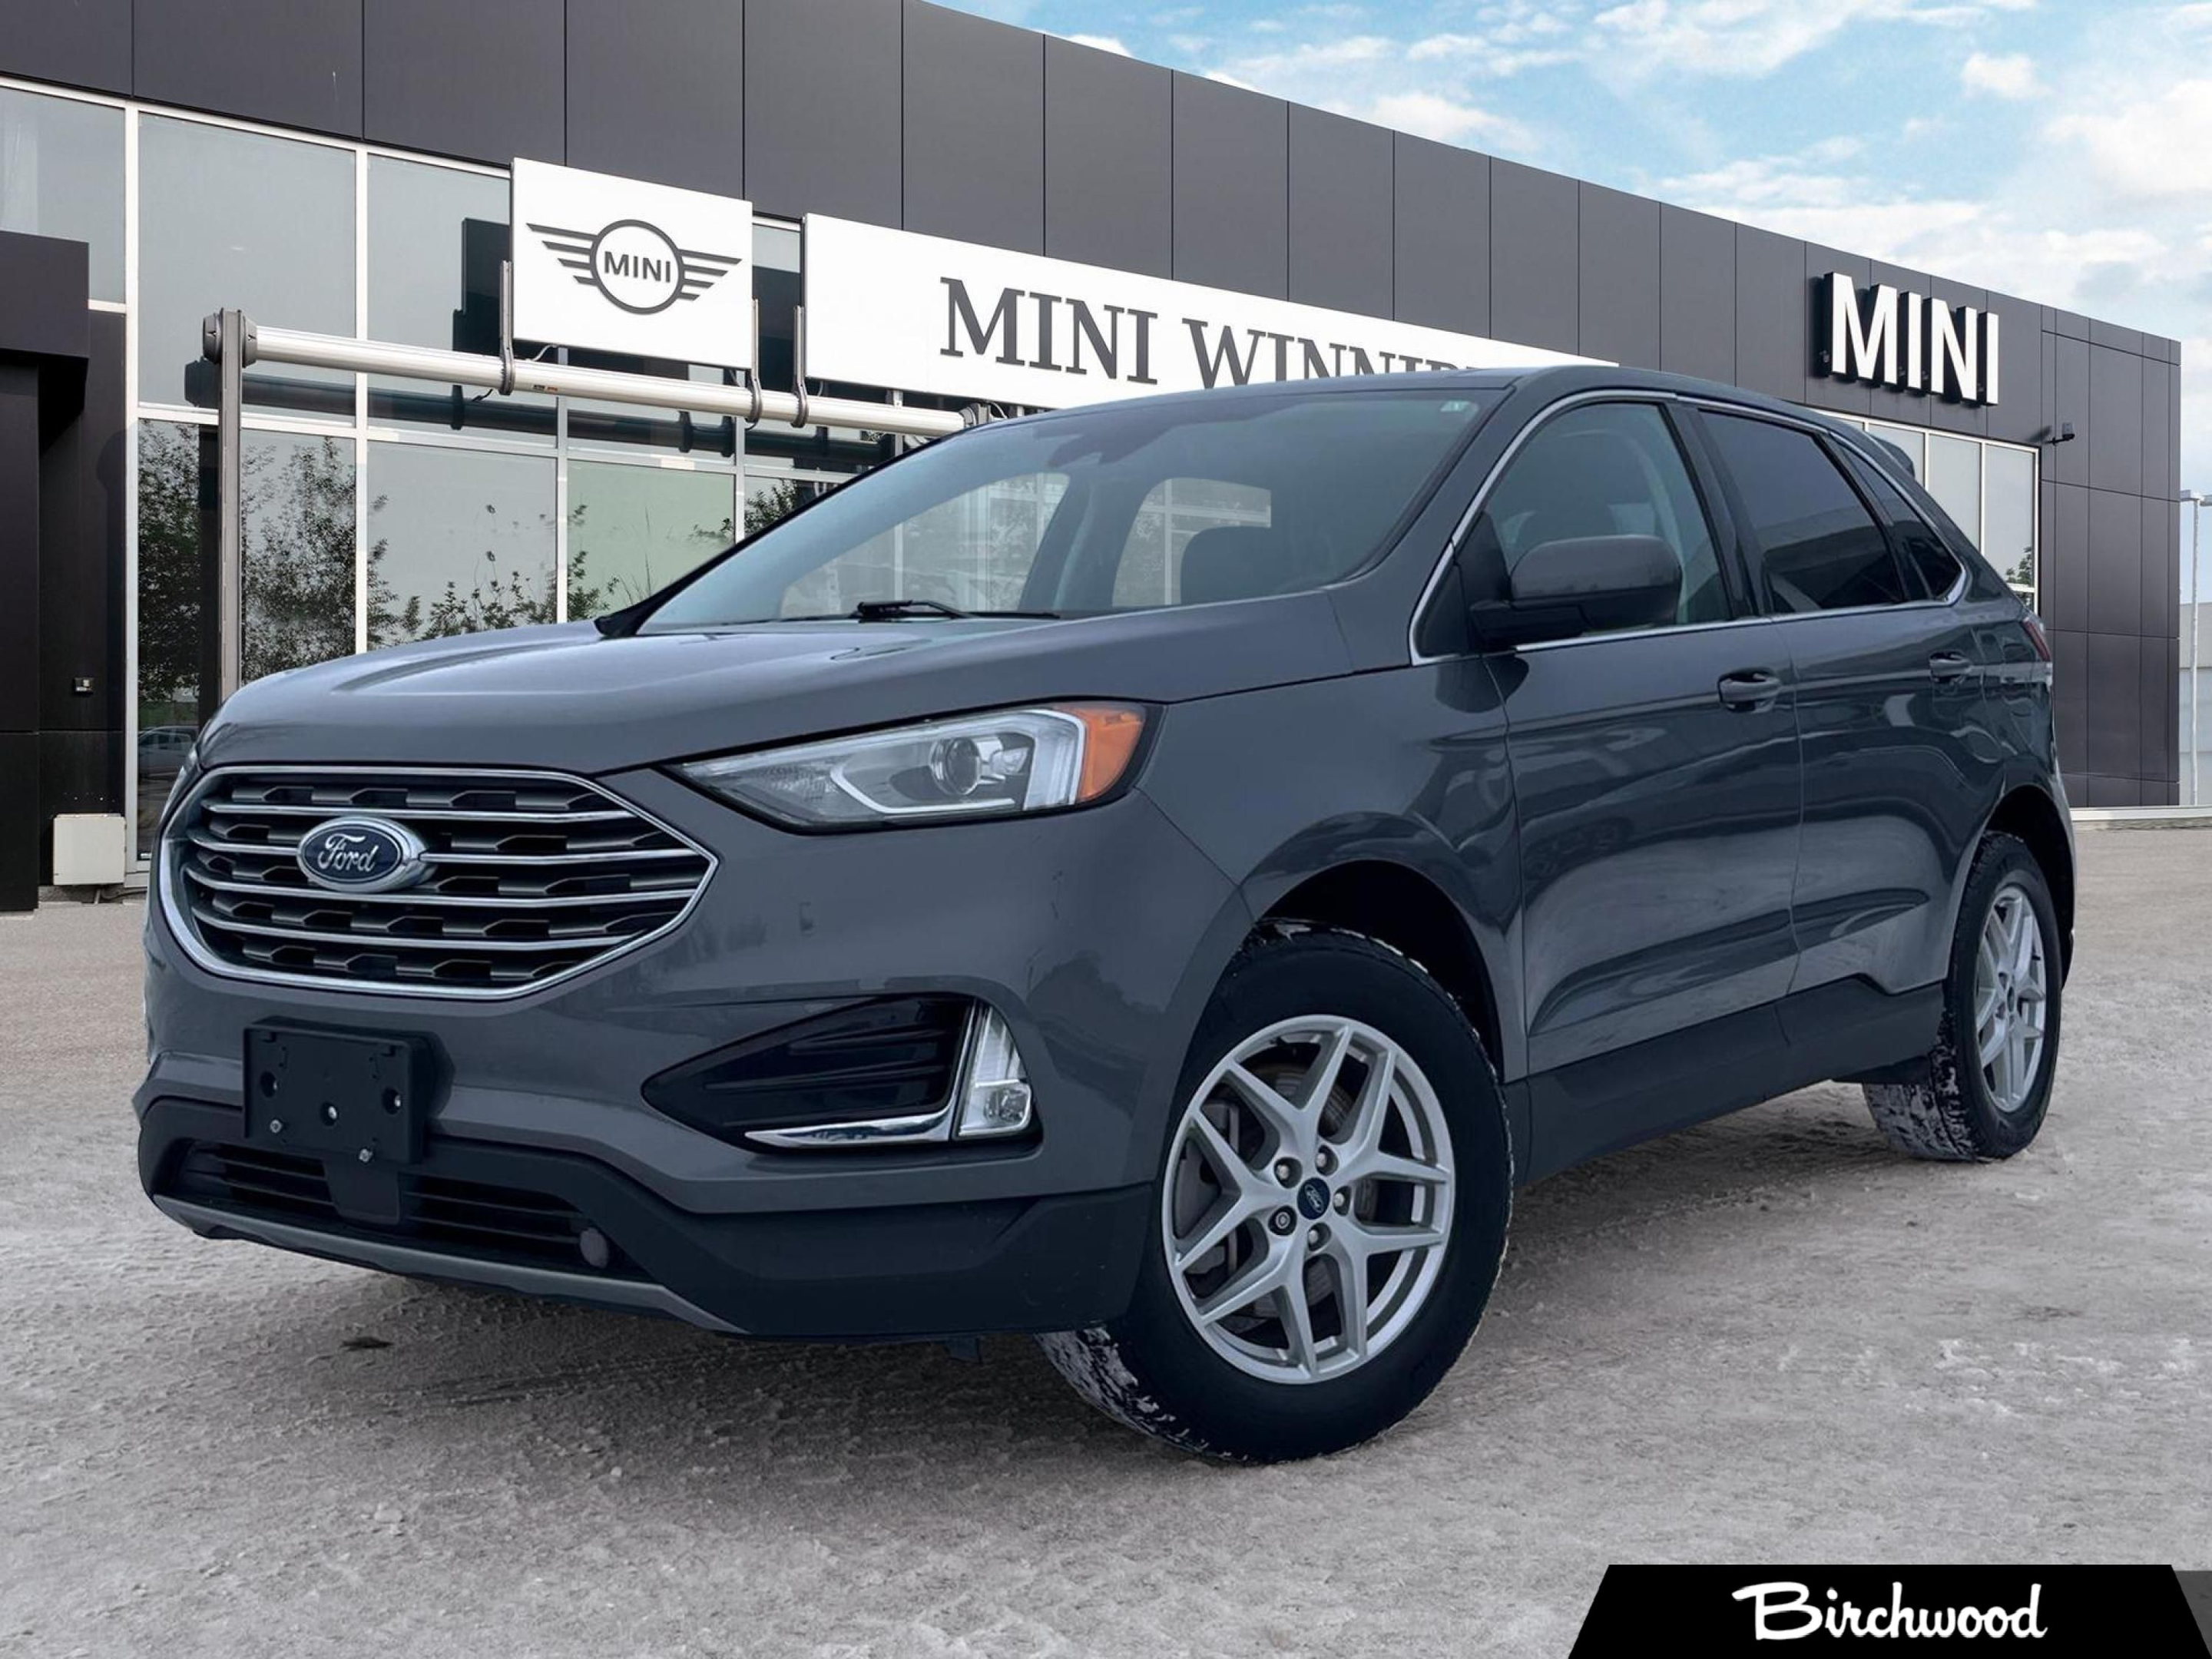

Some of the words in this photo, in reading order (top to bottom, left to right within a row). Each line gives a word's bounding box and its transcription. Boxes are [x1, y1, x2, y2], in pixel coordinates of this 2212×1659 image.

[604, 250, 671, 283] MINI
[940, 276, 1157, 386] MINI
[1831, 271, 1998, 405] MINI
[318, 833, 379, 872] Ford
